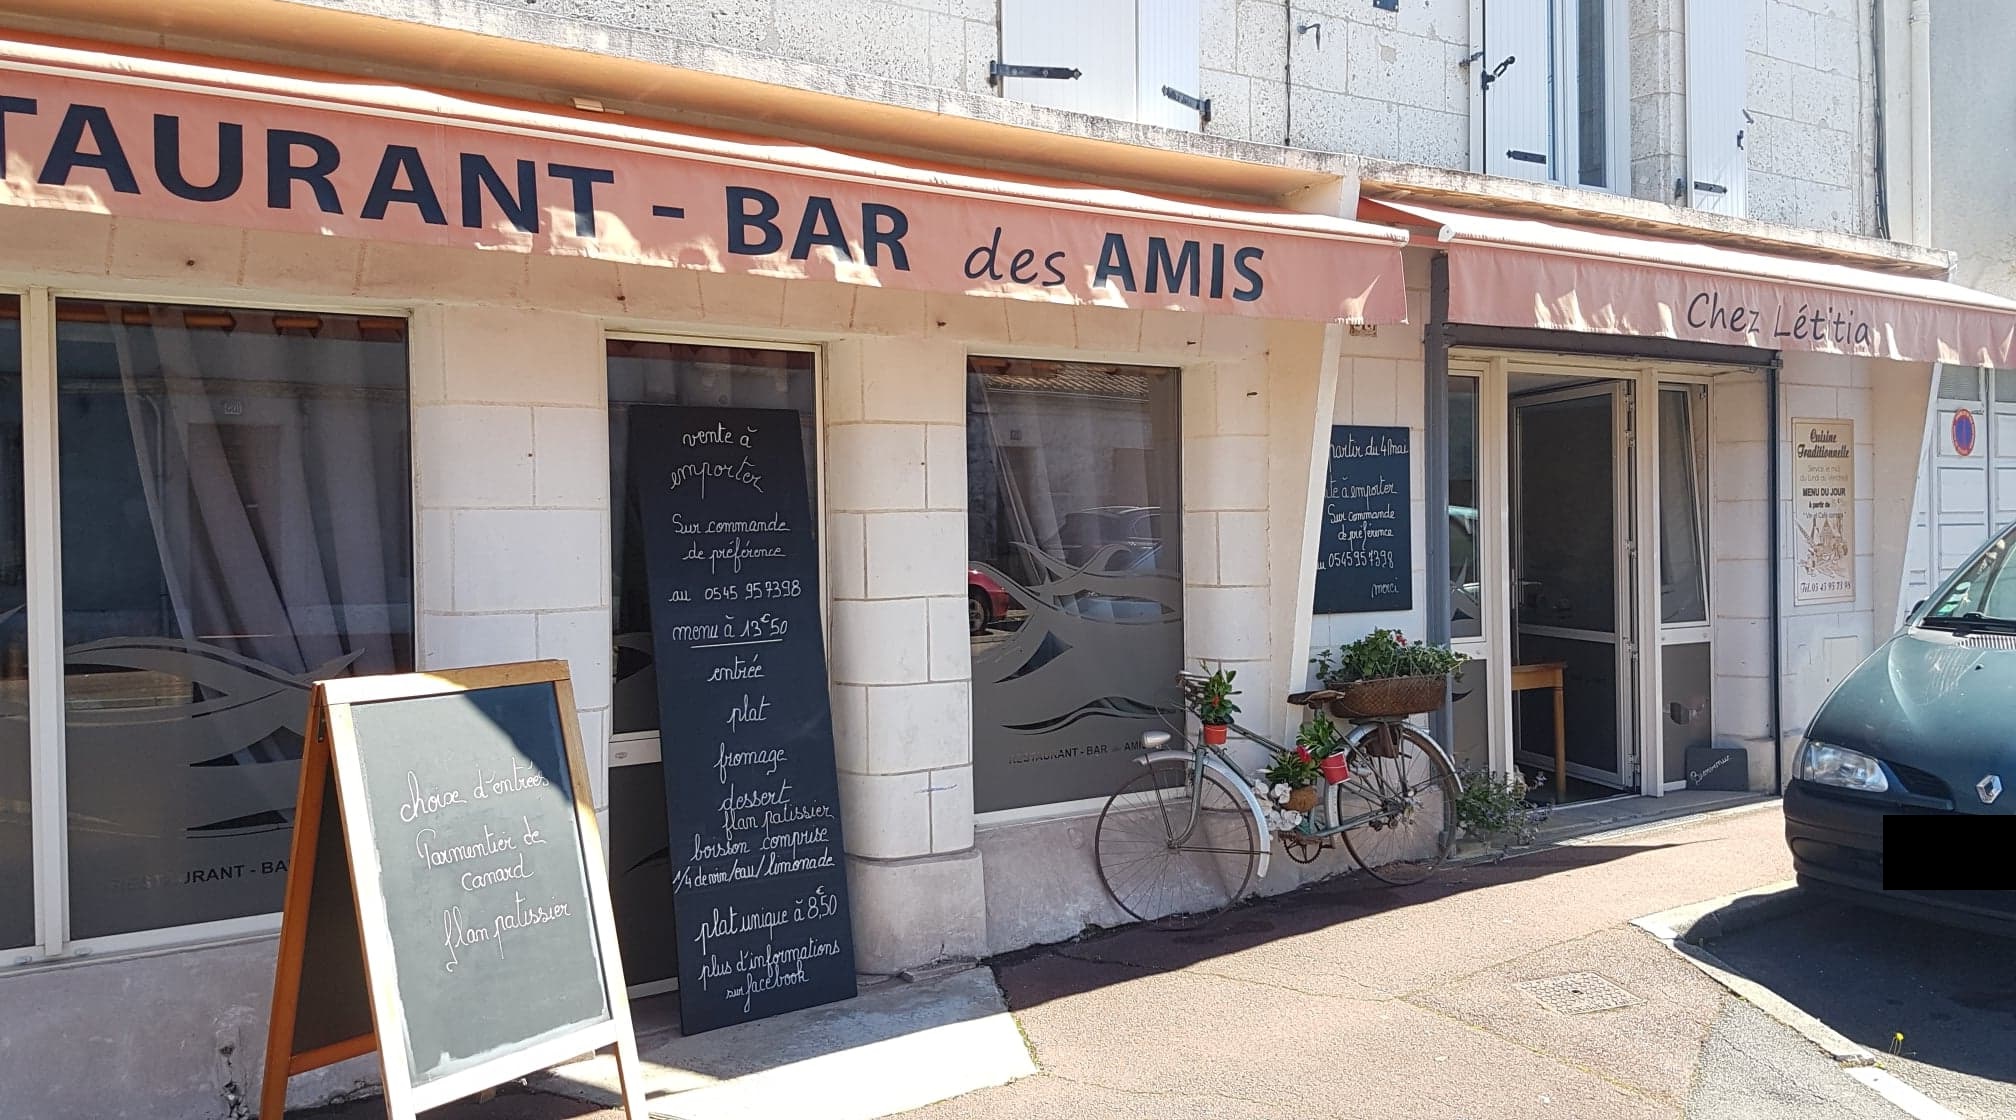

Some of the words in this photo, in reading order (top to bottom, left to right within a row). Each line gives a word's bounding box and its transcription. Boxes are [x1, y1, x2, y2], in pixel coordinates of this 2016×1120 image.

[725, 186, 911, 272] BAR
[963, 226, 1067, 288] des
[1093, 232, 1265, 302] AMIS
[1687, 291, 1760, 334] Chez
[1773, 303, 1871, 347] Létitia
[682, 421, 734, 447] vente
[1365, 435, 1381, 456] du
[670, 455, 764, 500] emporter
[1350, 475, 1398, 511] emporter
[1802, 487, 1820, 497] MENU
[1820, 487, 1830, 497] DU
[1830, 487, 1846, 497] JOUR
[672, 513, 701, 535] Sur
[704, 511, 791, 534] commande
[1348, 503, 1397, 522] commande
[681, 541, 705, 560] de
[709, 537, 788, 575] préférence
[668, 588, 692, 602] au
[672, 621, 719, 641] menu
[707, 654, 766, 682] entrée
[726, 693, 772, 734] plat
[713, 742, 788, 785] fromage
[718, 778, 793, 812] dessert
[522, 815, 547, 846] de
[690, 834, 751, 862] boisson
[759, 825, 830, 860] comprise
[261, 858, 291, 875] BA
[493, 889, 572, 961] patissier
[694, 906, 738, 956] plat
[739, 907, 789, 941] unique
[698, 954, 733, 992] plus
